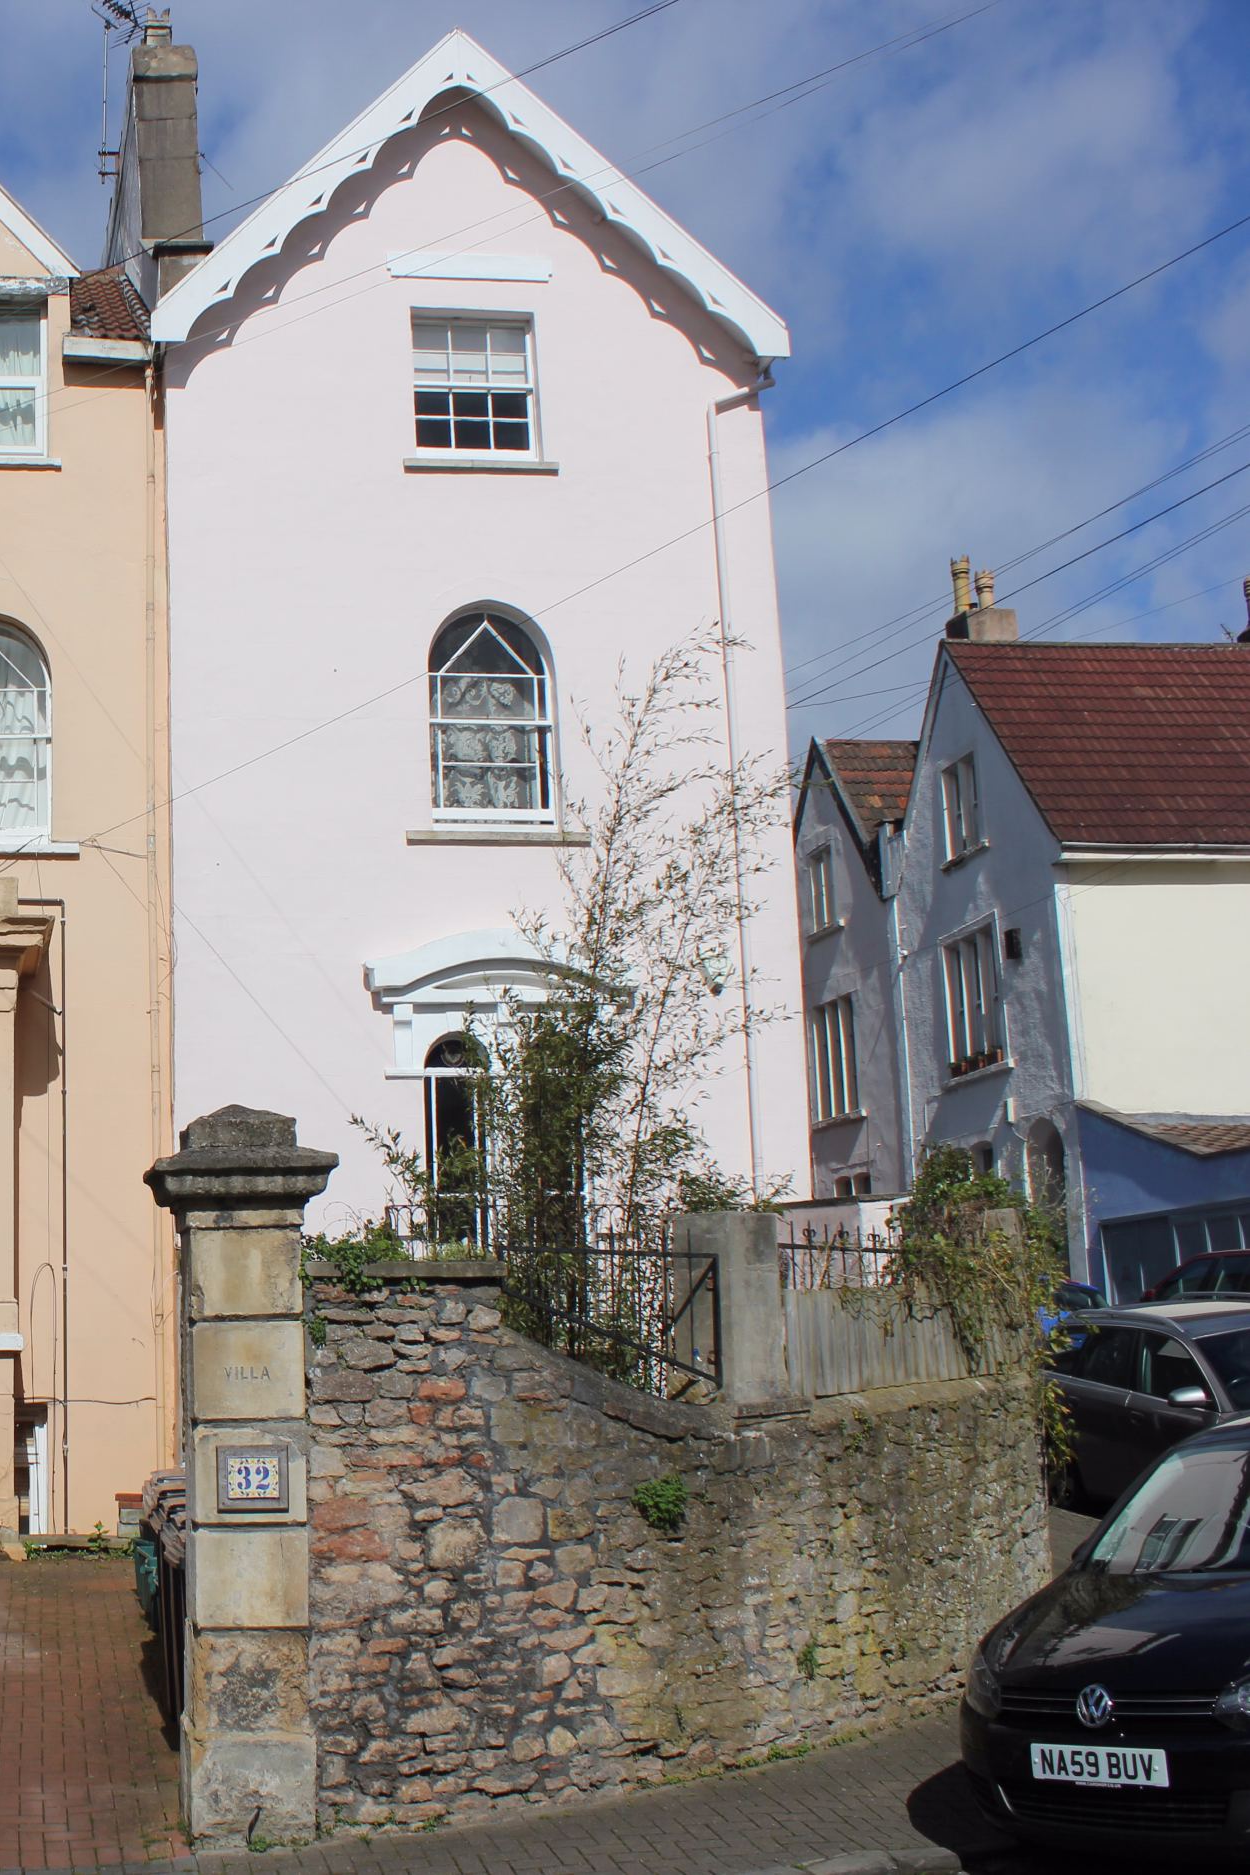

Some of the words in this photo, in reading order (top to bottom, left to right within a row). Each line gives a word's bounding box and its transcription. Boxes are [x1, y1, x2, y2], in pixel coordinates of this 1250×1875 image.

[224, 1366, 271, 1380] VILLA
[237, 1466, 270, 1490] 32
[1040, 1748, 1100, 1778] NA59
[1106, 1752, 1153, 1781] BUV
